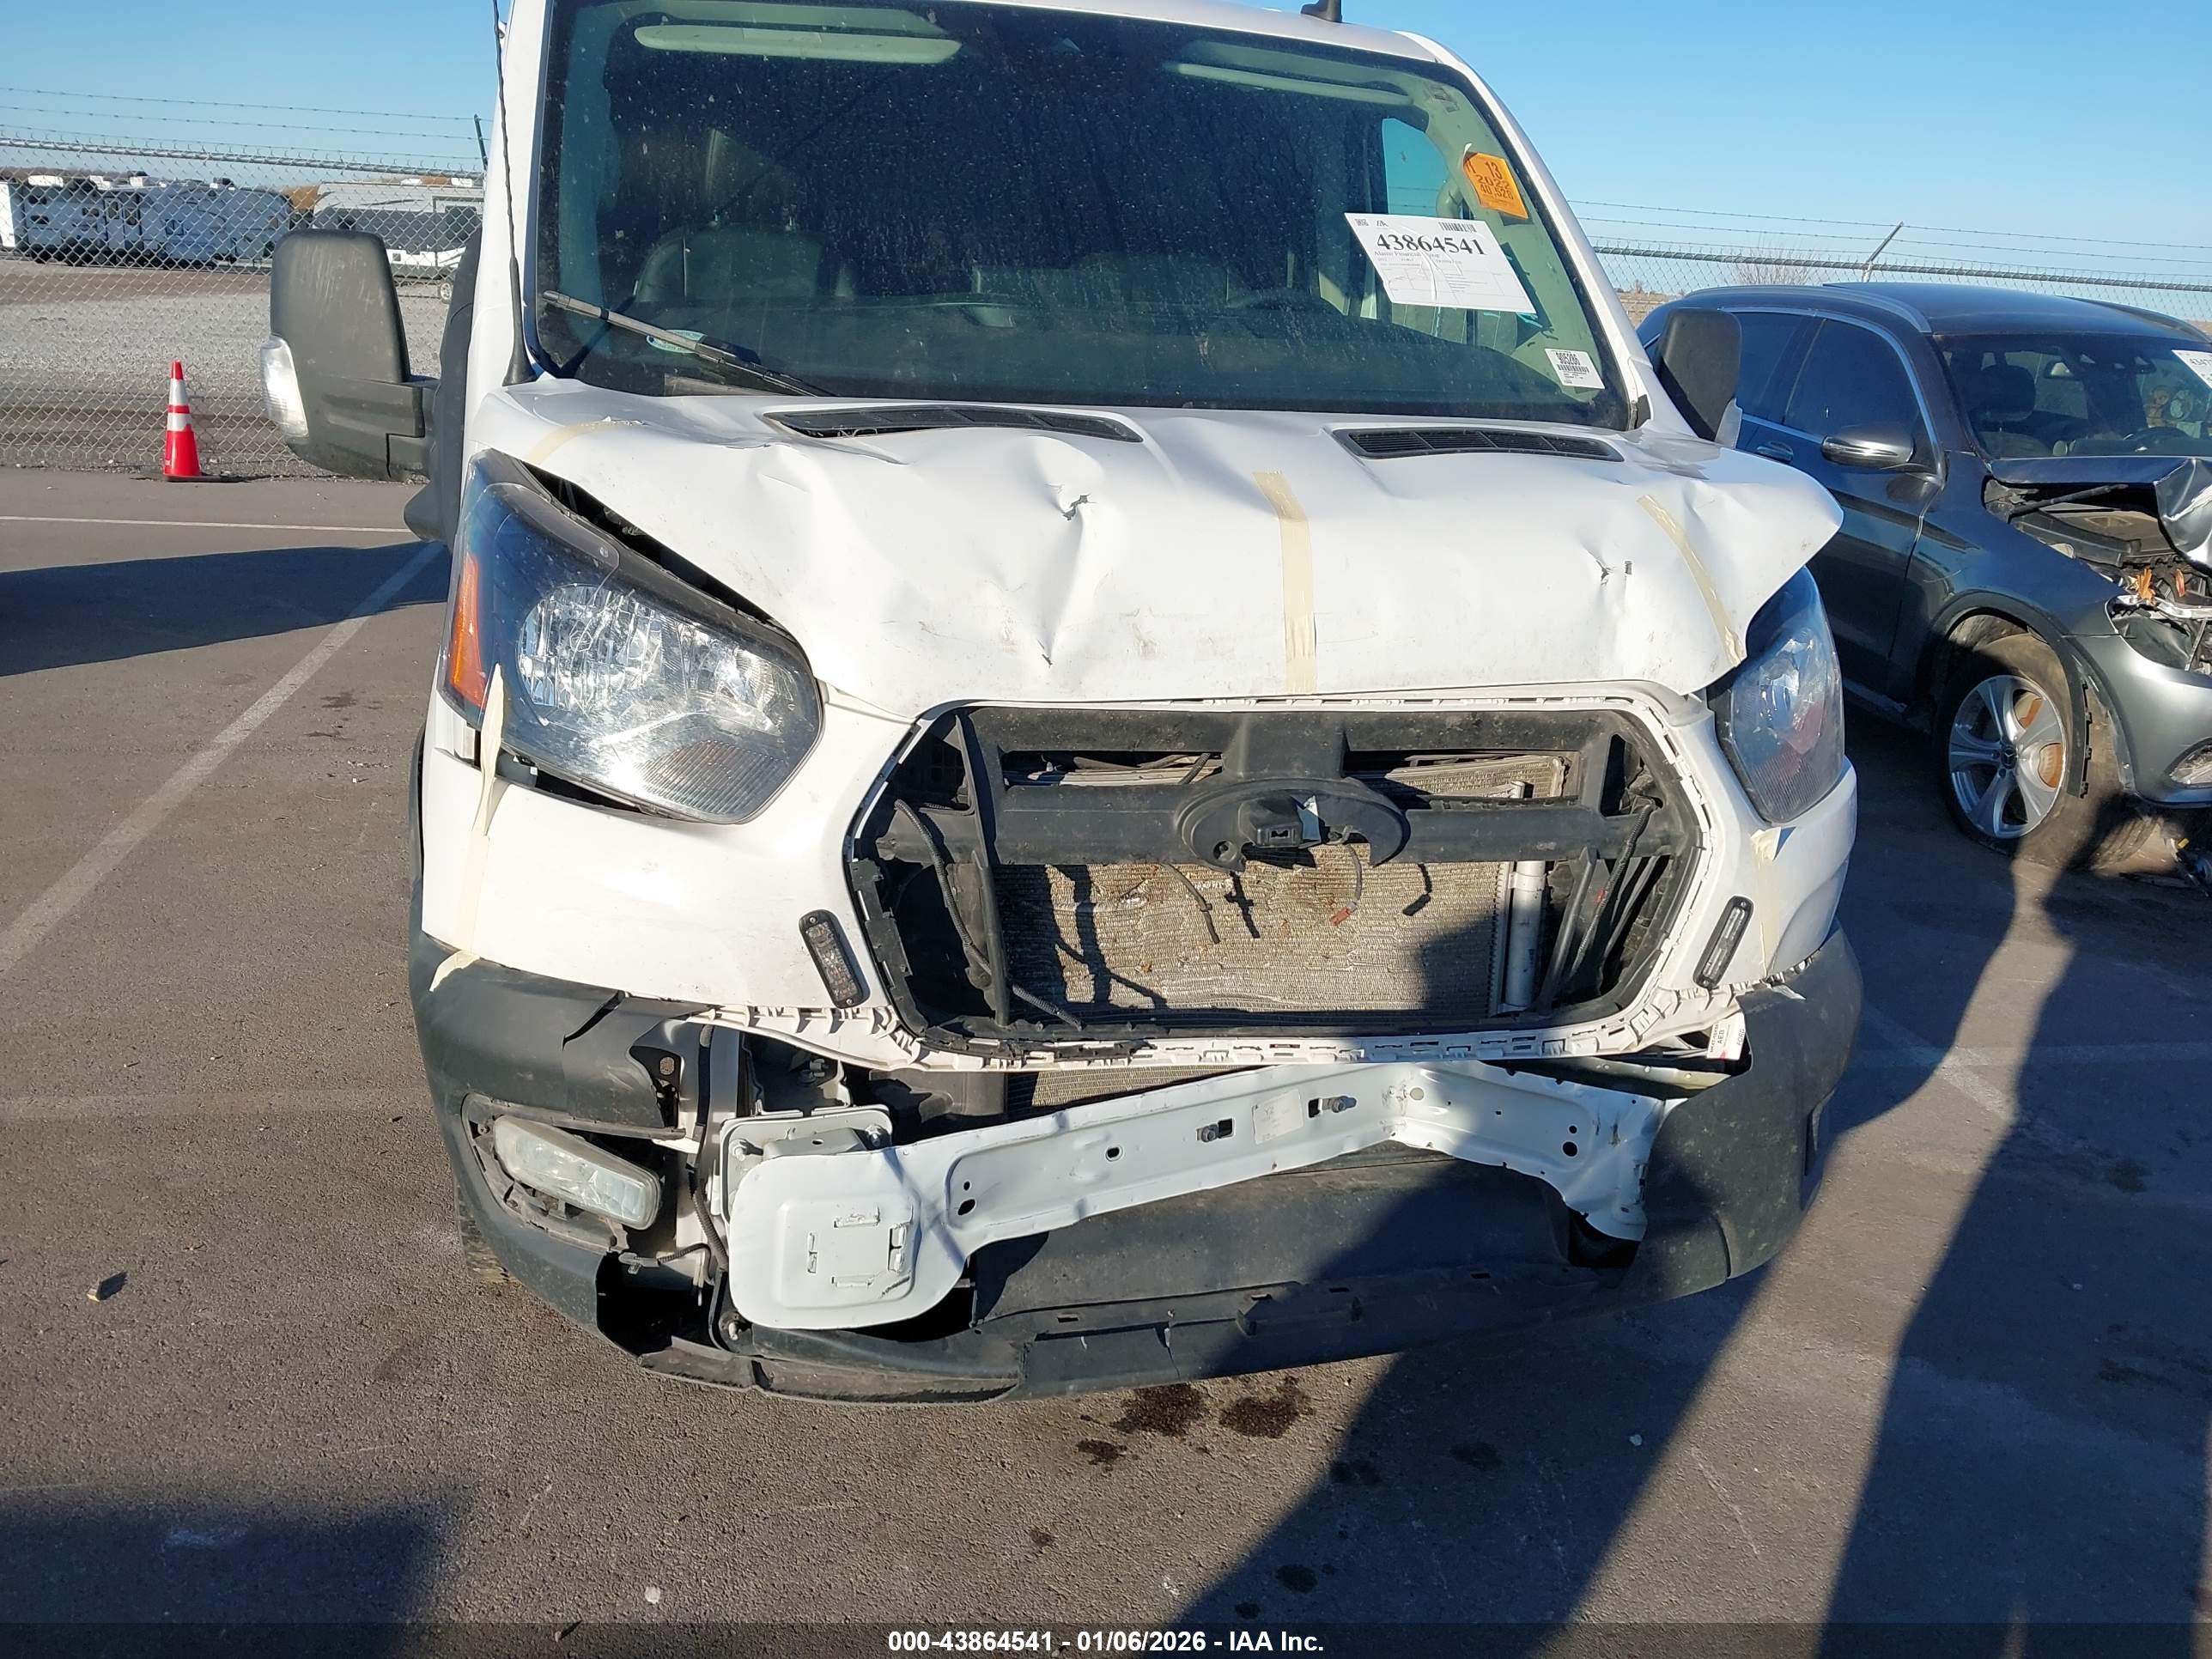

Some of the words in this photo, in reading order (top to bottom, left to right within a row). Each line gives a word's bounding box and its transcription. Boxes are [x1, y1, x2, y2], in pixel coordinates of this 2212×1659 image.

[1485, 161, 1503, 179] 13
[1475, 174, 1510, 189] 2022
[1376, 234, 1486, 255] 43864541
